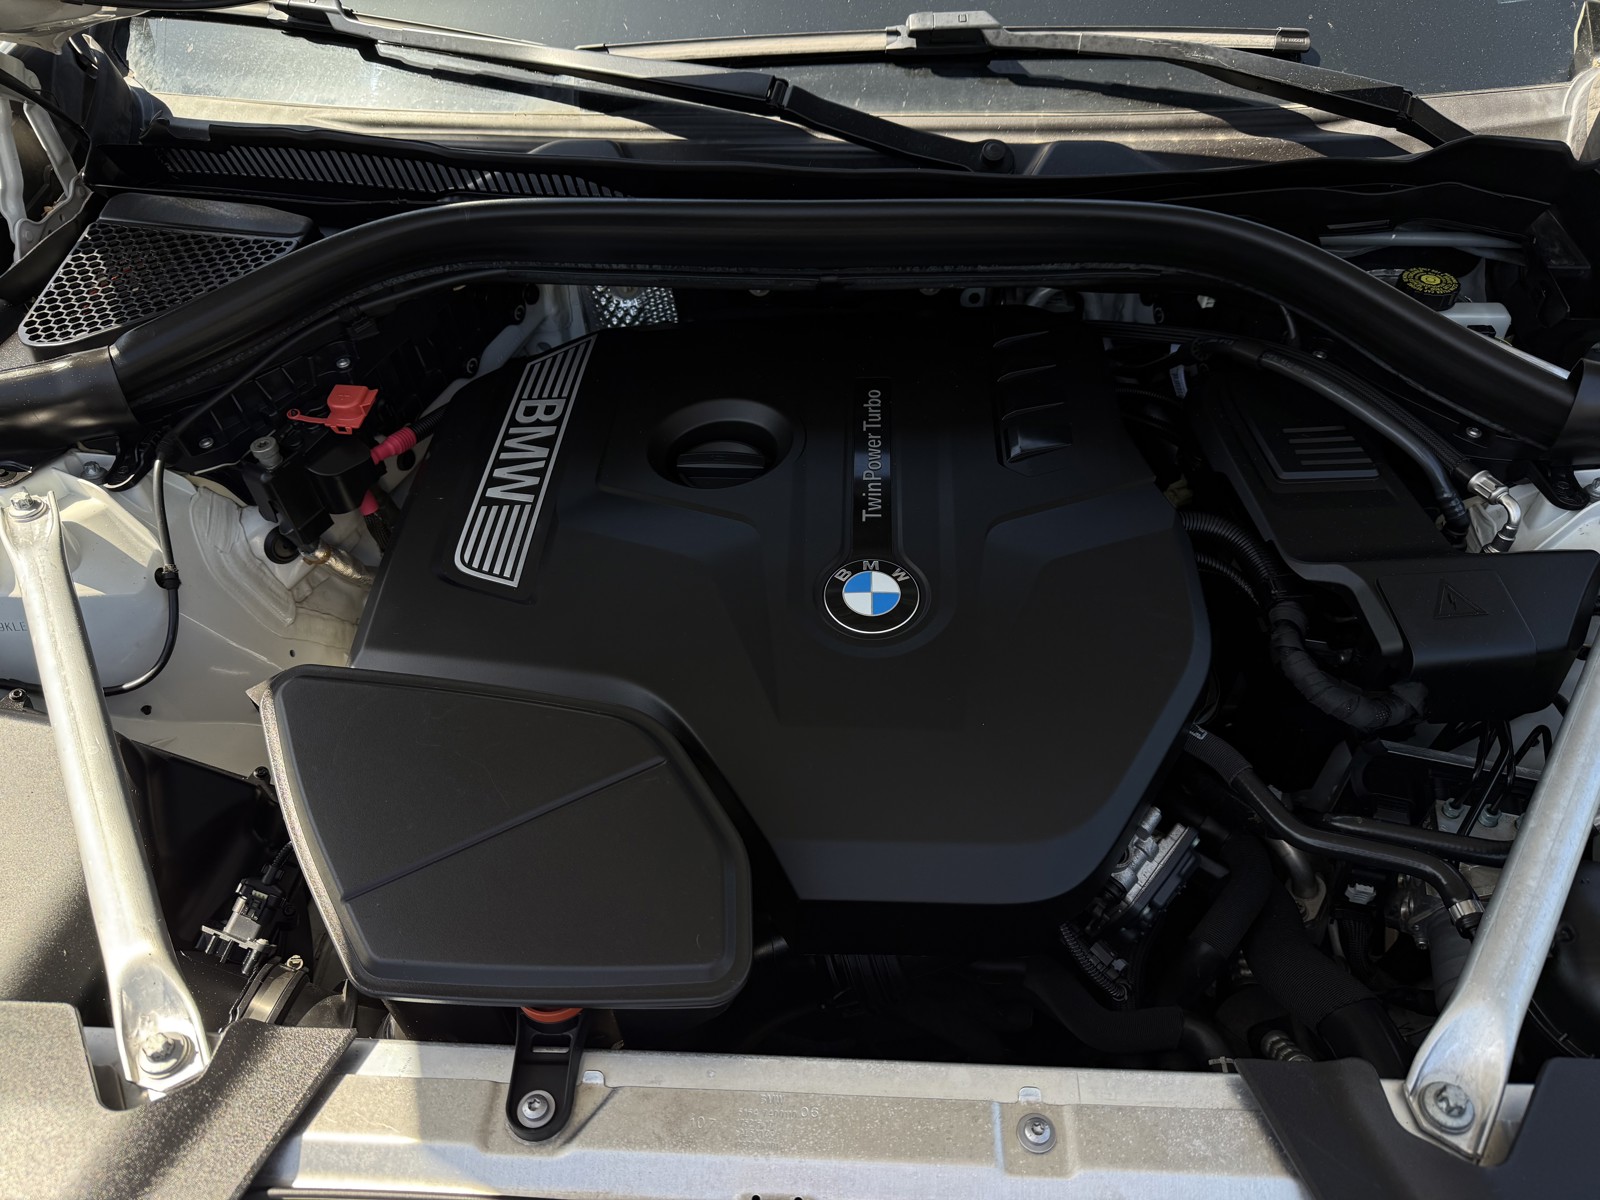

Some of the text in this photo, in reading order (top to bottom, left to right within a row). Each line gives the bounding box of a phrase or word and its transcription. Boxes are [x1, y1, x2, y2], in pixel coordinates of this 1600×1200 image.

[485, 399, 566, 503] BMW
[862, 389, 882, 522] TwinPower Turbo
[834, 560, 910, 583] BMW
